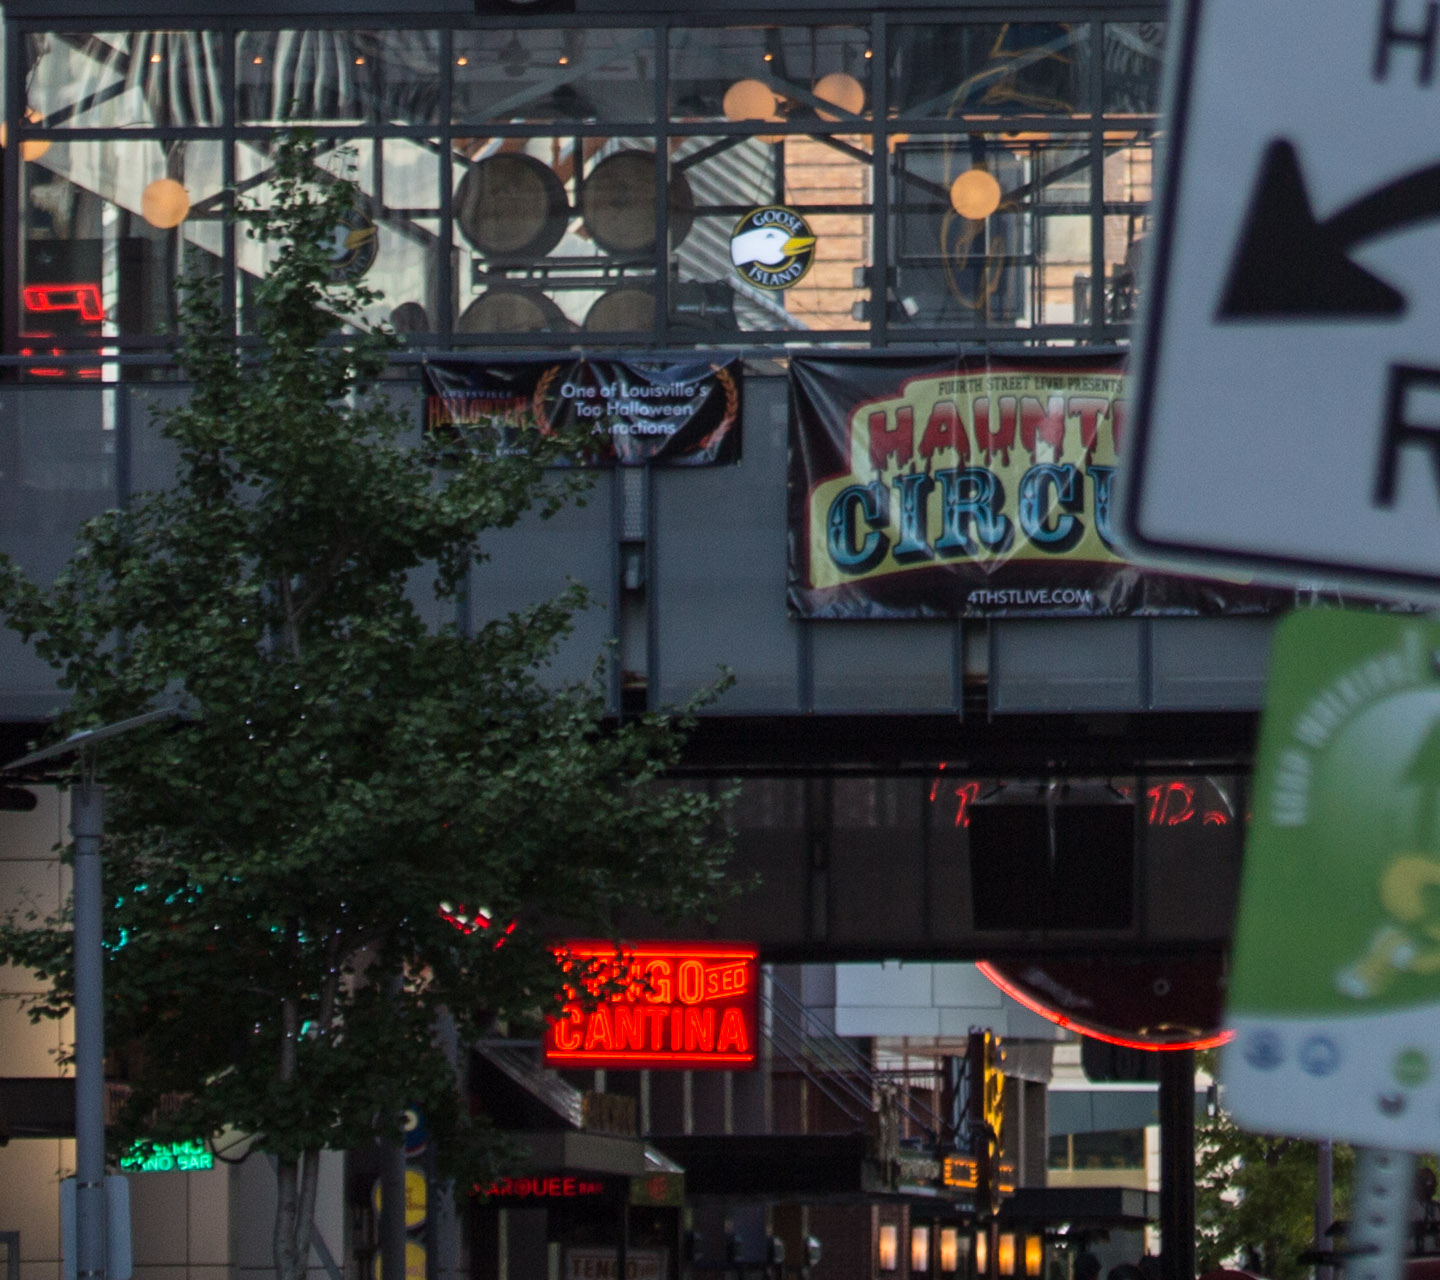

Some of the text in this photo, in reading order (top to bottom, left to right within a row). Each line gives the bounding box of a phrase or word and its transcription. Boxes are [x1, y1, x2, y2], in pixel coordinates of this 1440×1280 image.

[752, 210, 803, 233] GOOSE
[747, 261, 803, 286] ISLAND
[560, 381, 709, 399] One of Louisville's
[938, 377, 983, 396] FOURTH
[987, 375, 1031, 392] STREET
[1067, 376, 1123, 395] PRESENTS
[574, 401, 694, 418] Top Halloween
[967, 587, 1093, 606] 4THSTLIVE.COM
[553, 1004, 749, 1053] CANTINA
